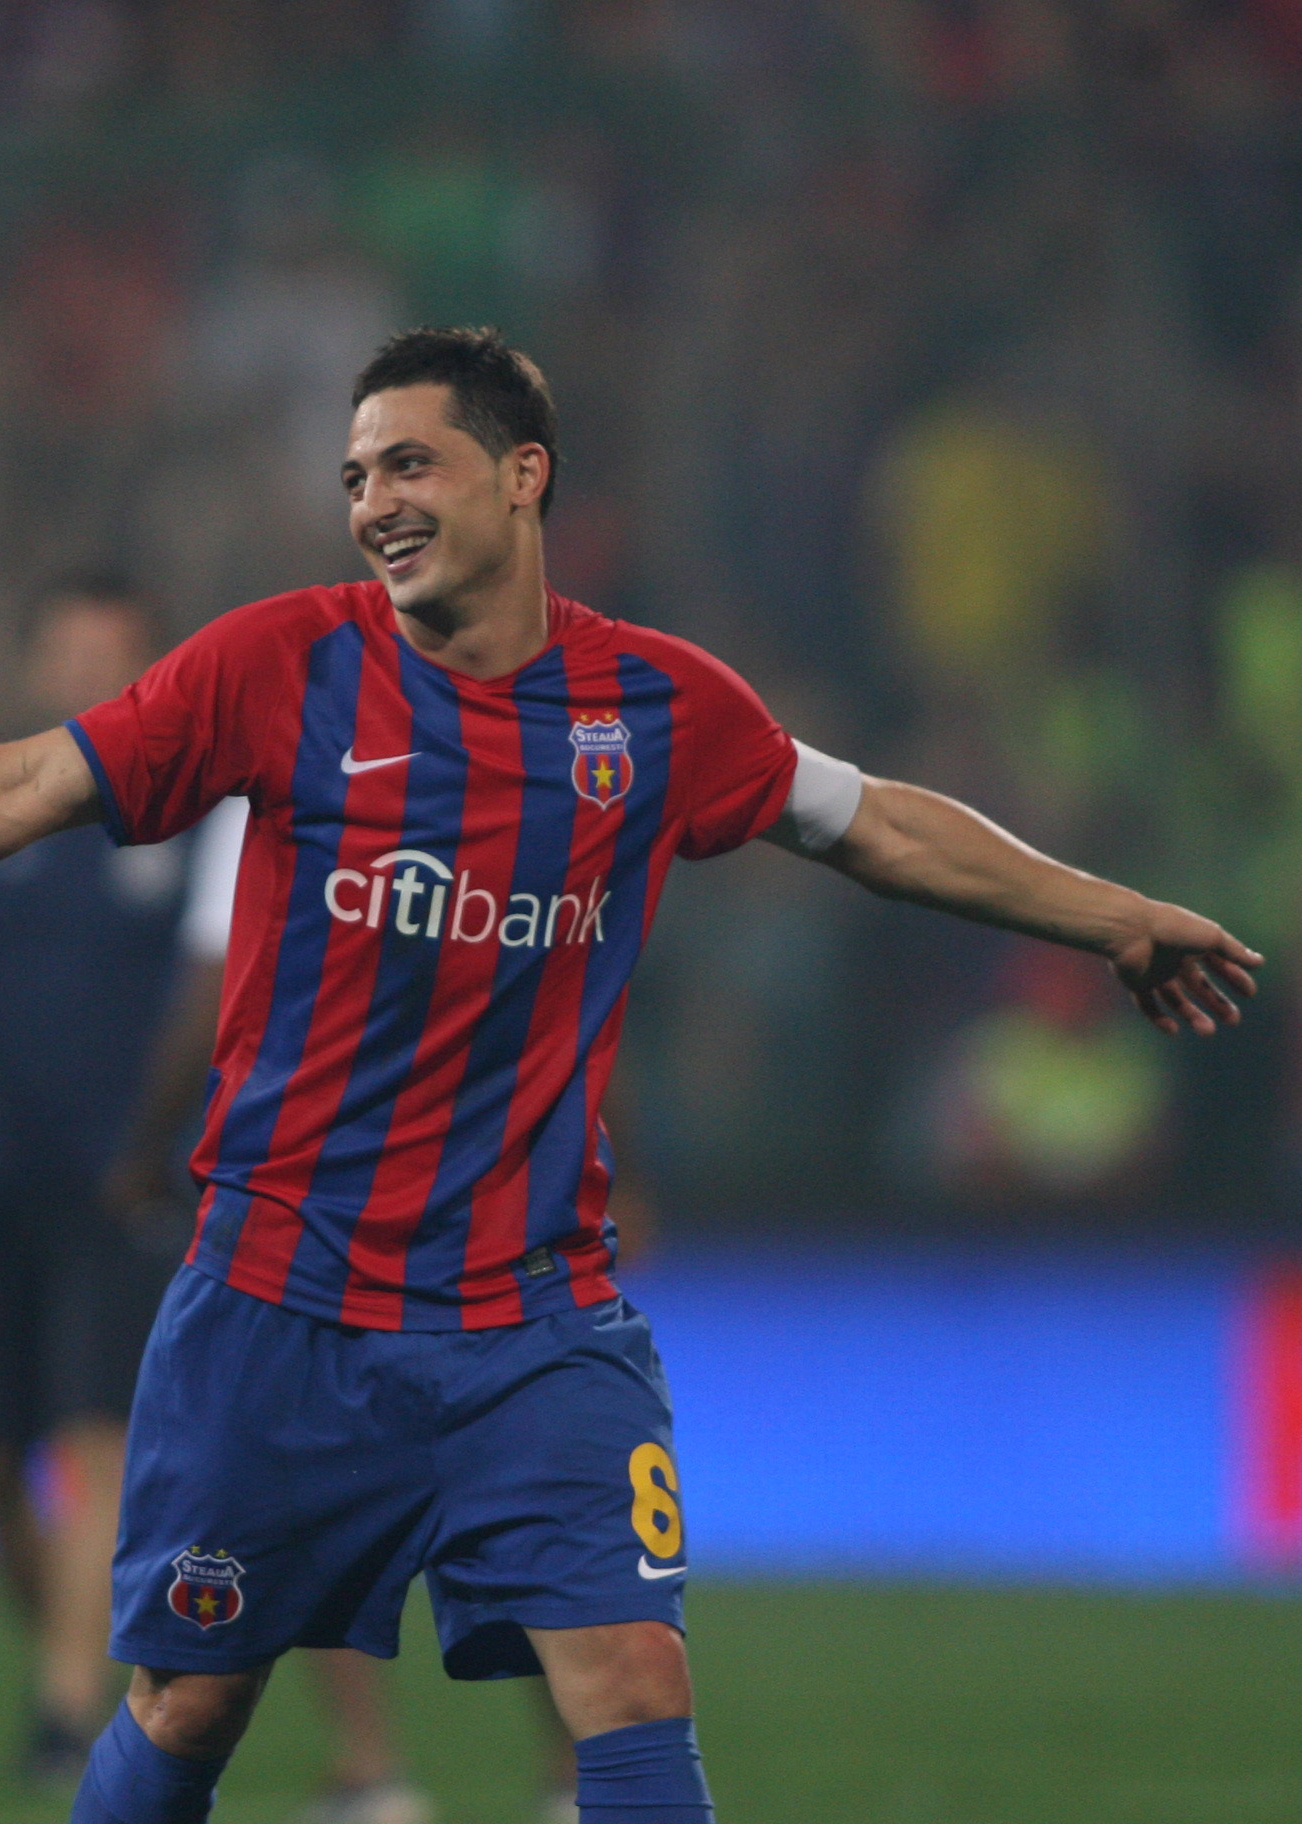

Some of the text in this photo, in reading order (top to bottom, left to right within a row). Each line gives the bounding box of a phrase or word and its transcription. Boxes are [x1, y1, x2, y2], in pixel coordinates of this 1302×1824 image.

[576, 728, 624, 742] STEAUA
[324, 850, 611, 948] citibank
[629, 1442, 681, 1559] 6
[181, 1560, 234, 1577] STEAUA
